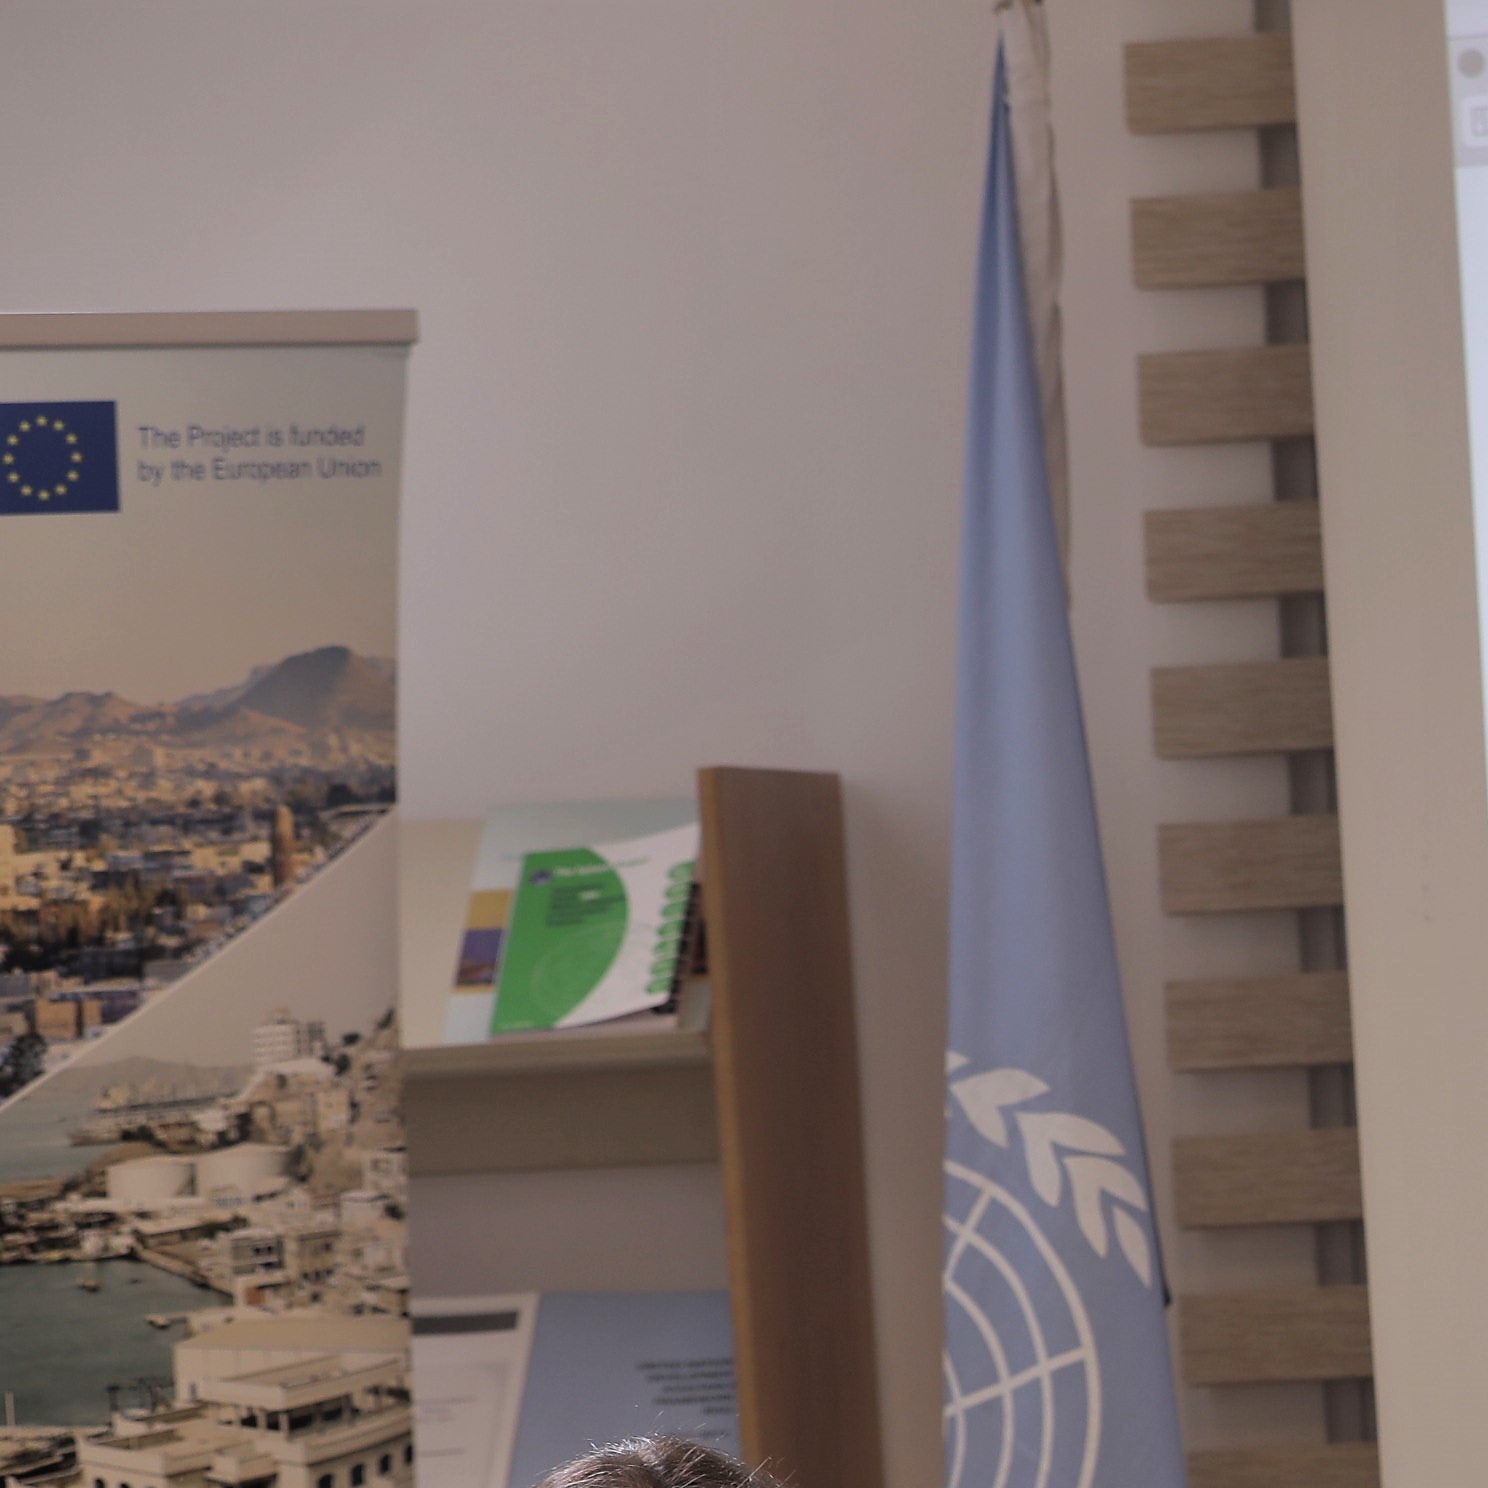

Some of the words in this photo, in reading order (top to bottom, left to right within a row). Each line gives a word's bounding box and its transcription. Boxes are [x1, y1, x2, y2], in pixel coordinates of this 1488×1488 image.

[137, 425, 182, 450] The
[187, 424, 260, 453] Project
[268, 426, 284, 448] is
[289, 423, 366, 448] funded
[137, 458, 163, 487] by
[170, 457, 206, 482] the
[211, 457, 313, 485] European
[318, 455, 383, 481] Union
